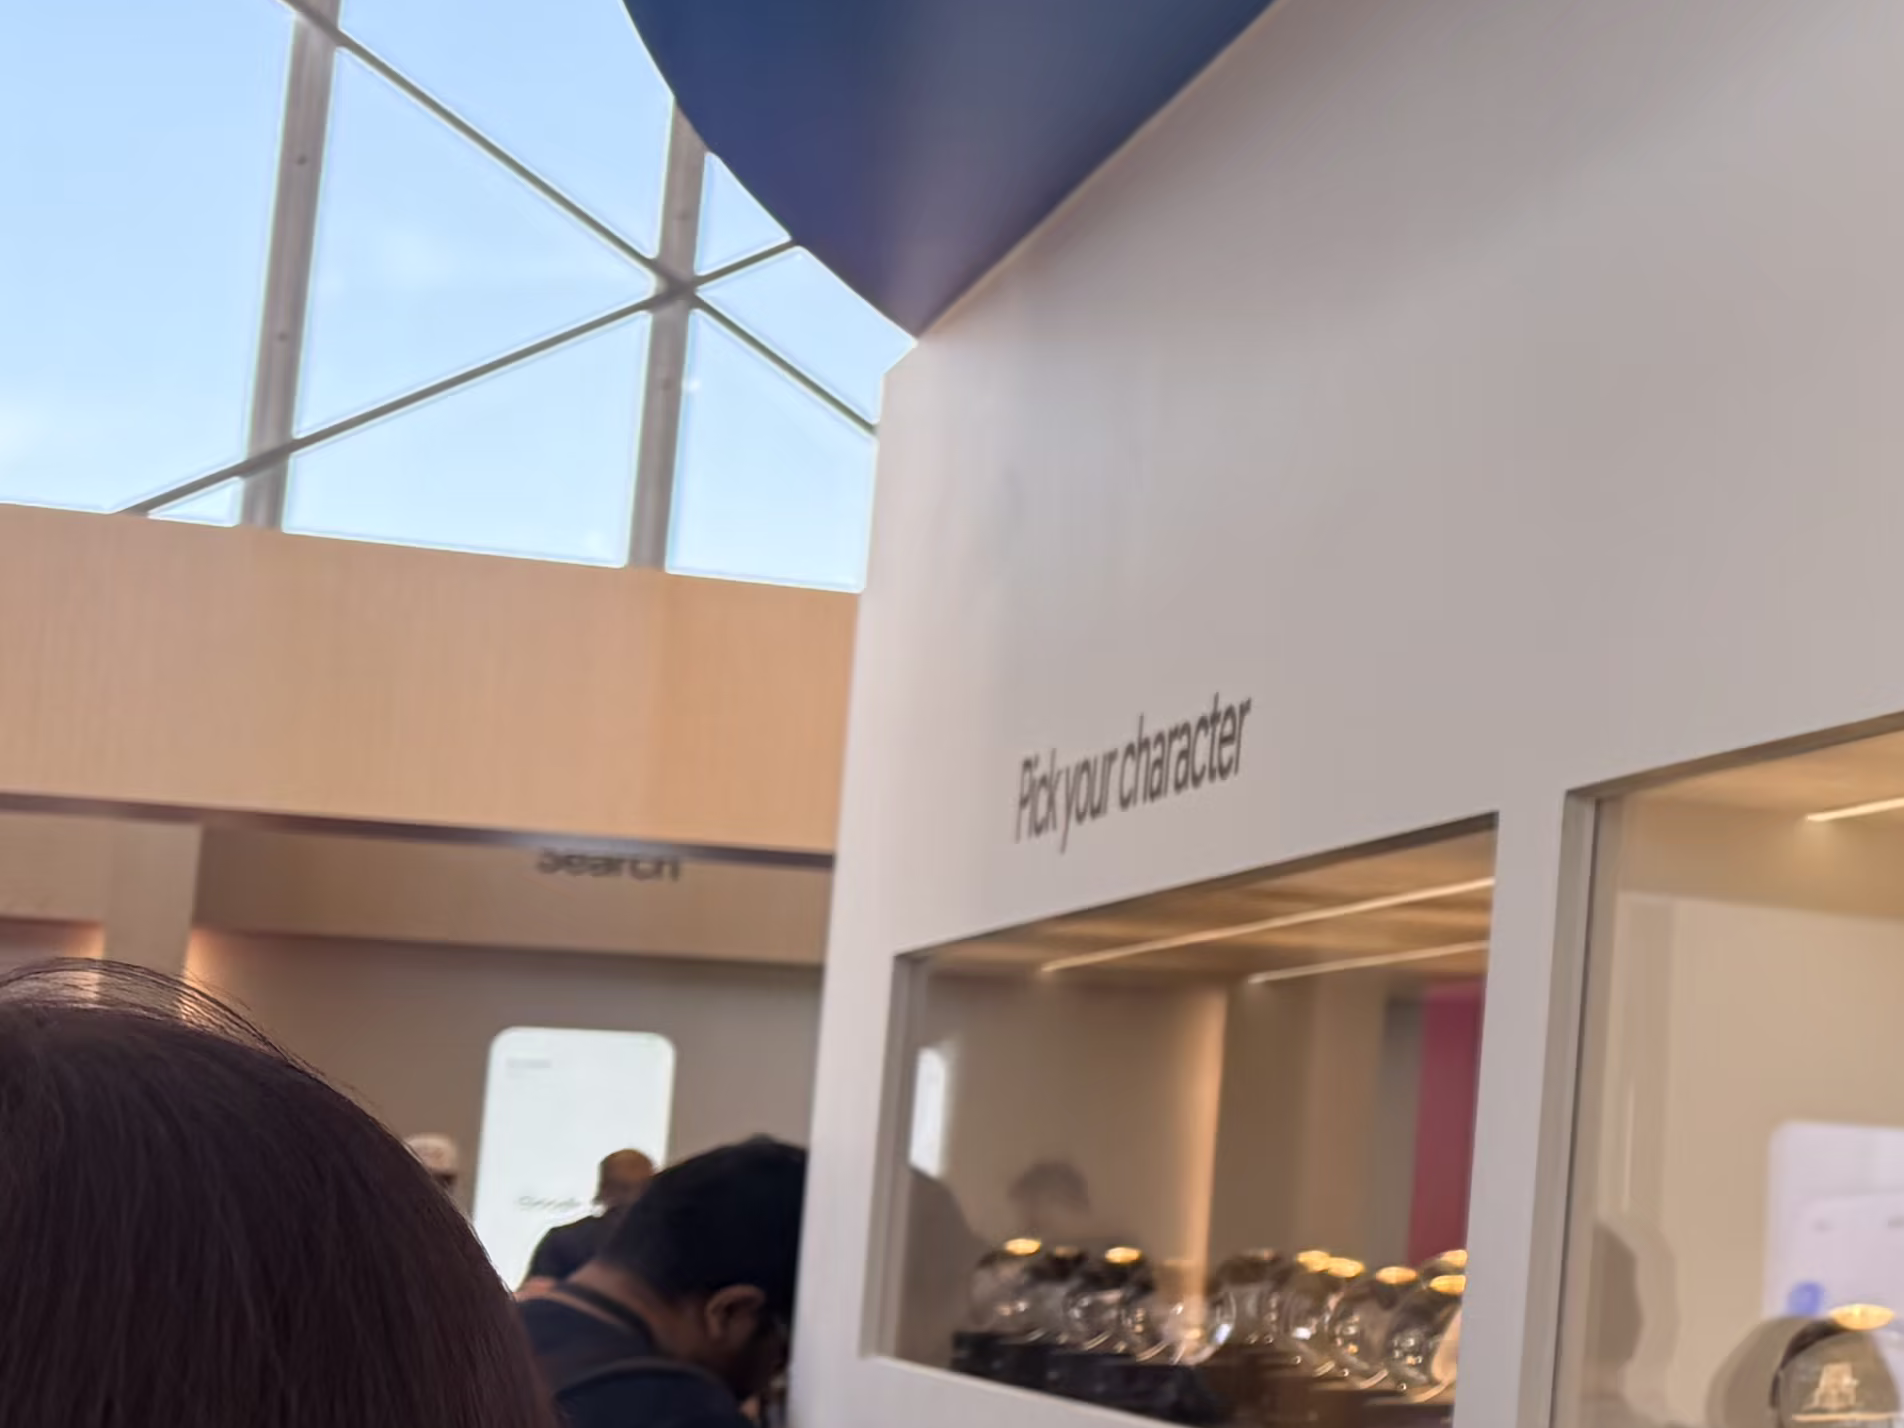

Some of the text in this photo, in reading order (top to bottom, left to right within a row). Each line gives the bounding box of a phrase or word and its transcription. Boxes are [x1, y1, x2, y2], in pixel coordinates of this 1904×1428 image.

[1014, 691, 1252, 855] Pick your character
